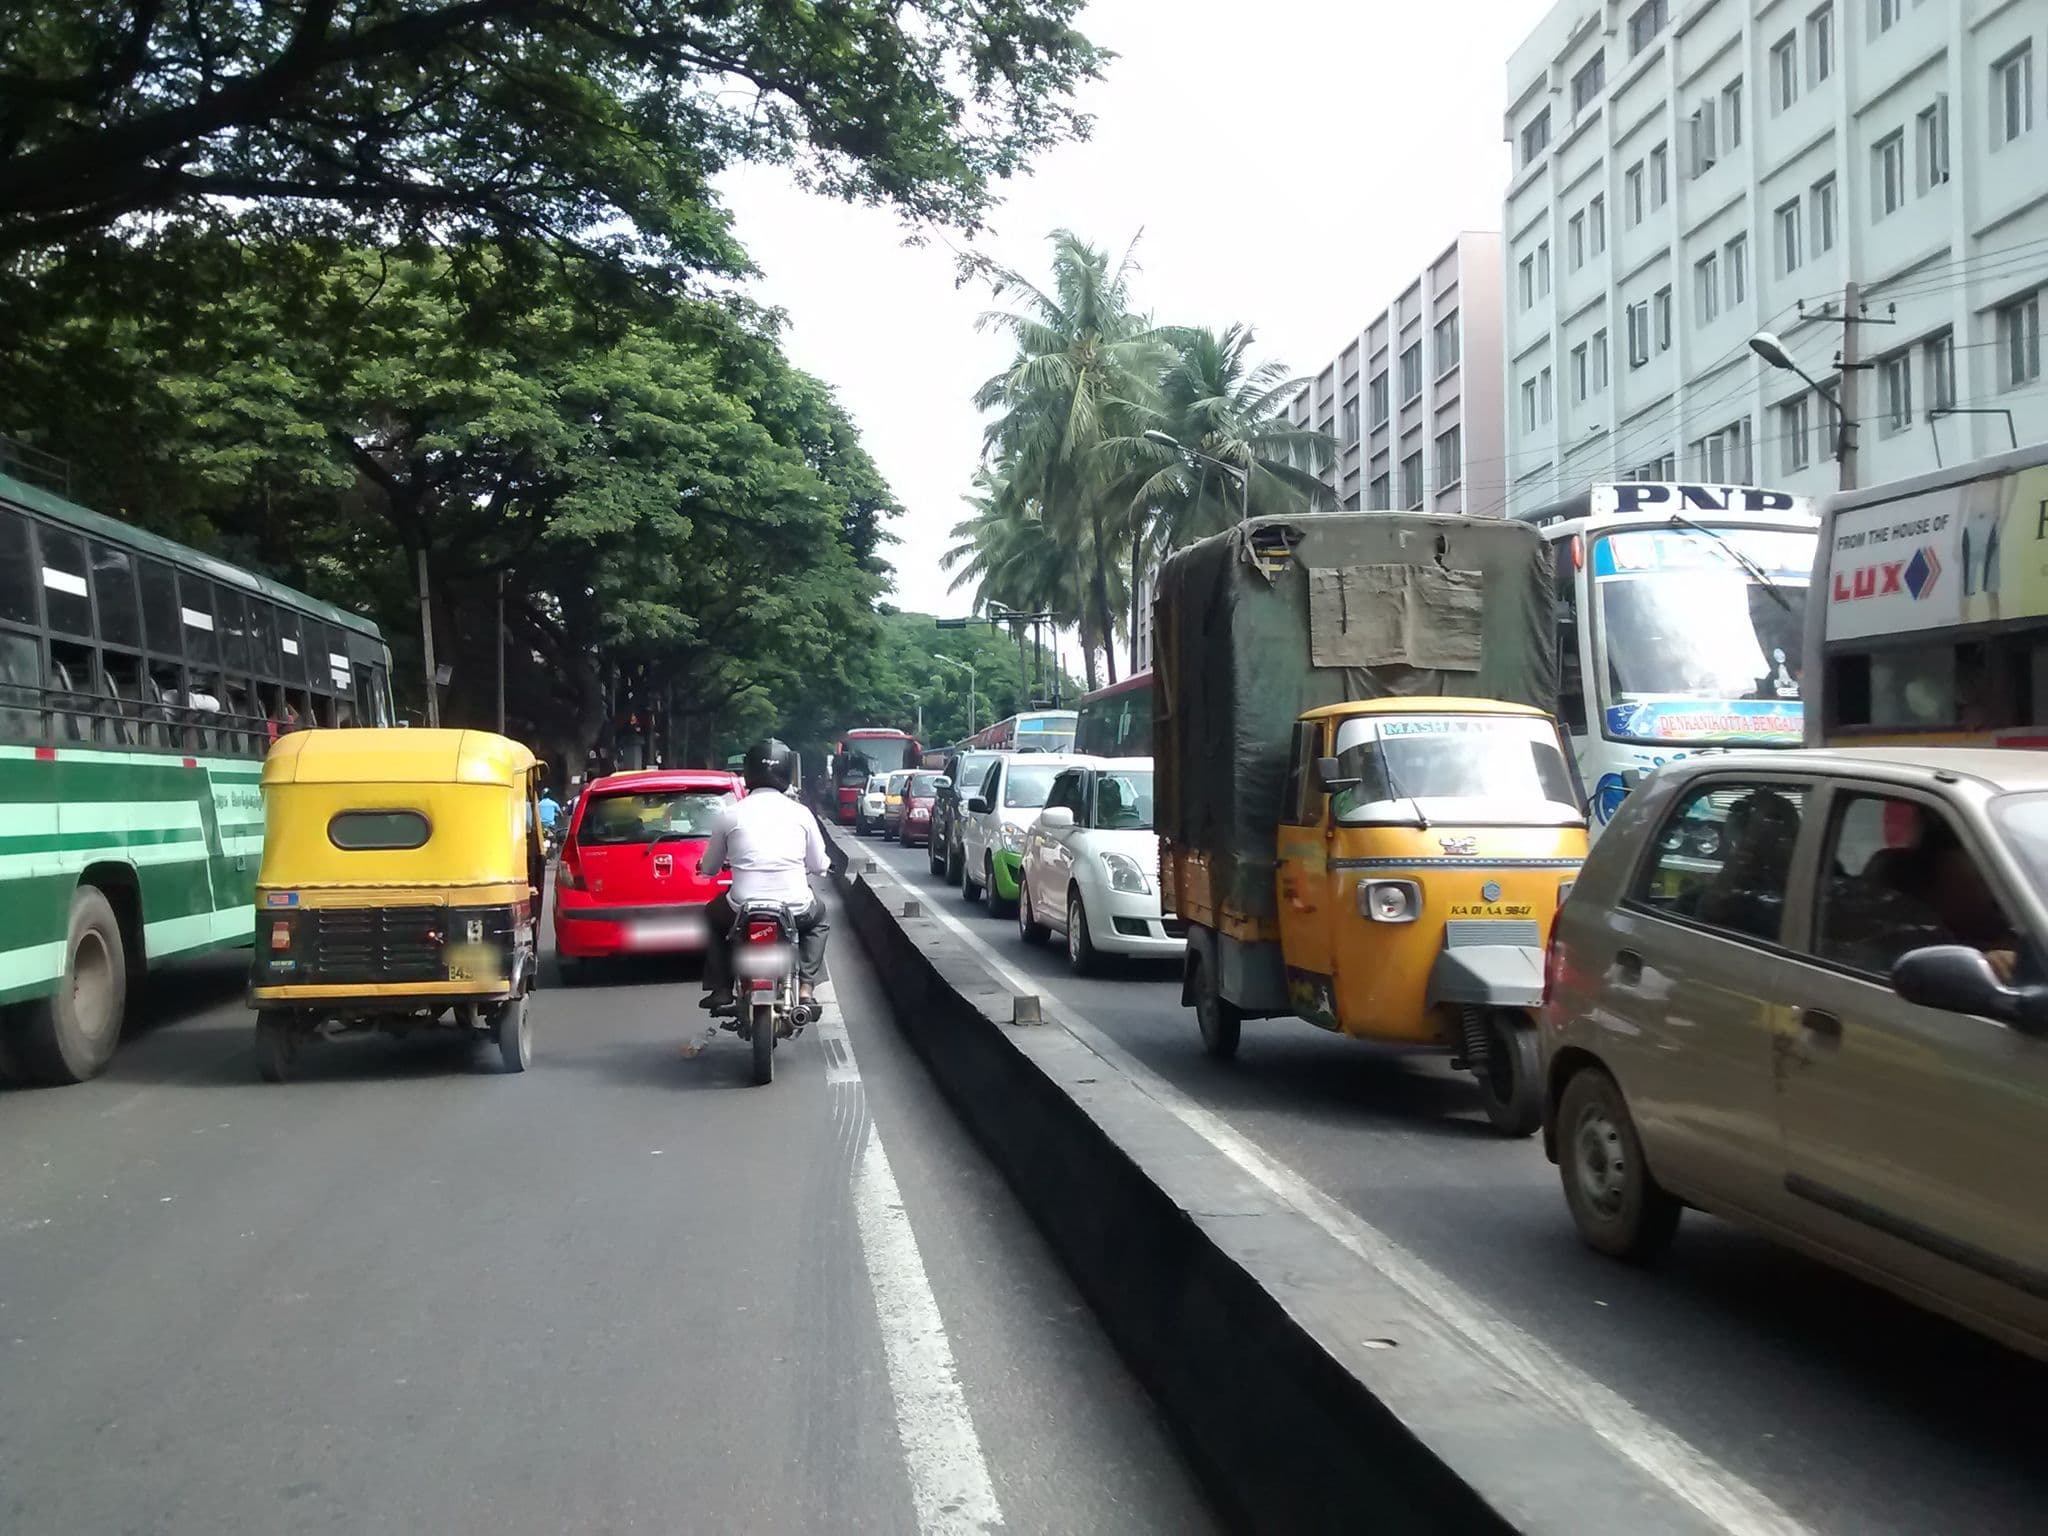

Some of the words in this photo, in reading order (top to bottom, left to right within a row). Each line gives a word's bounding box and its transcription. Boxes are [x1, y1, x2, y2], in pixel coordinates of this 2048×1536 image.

[1613, 485, 1794, 513] PNP
[1837, 532, 1866, 550] FROM
[1868, 526, 1889, 544] THE
[1891, 518, 1931, 540] HOUSE
[1932, 514, 1950, 532] OF
[1833, 560, 1904, 603] LUX
[1450, 905, 1468, 915] KA
